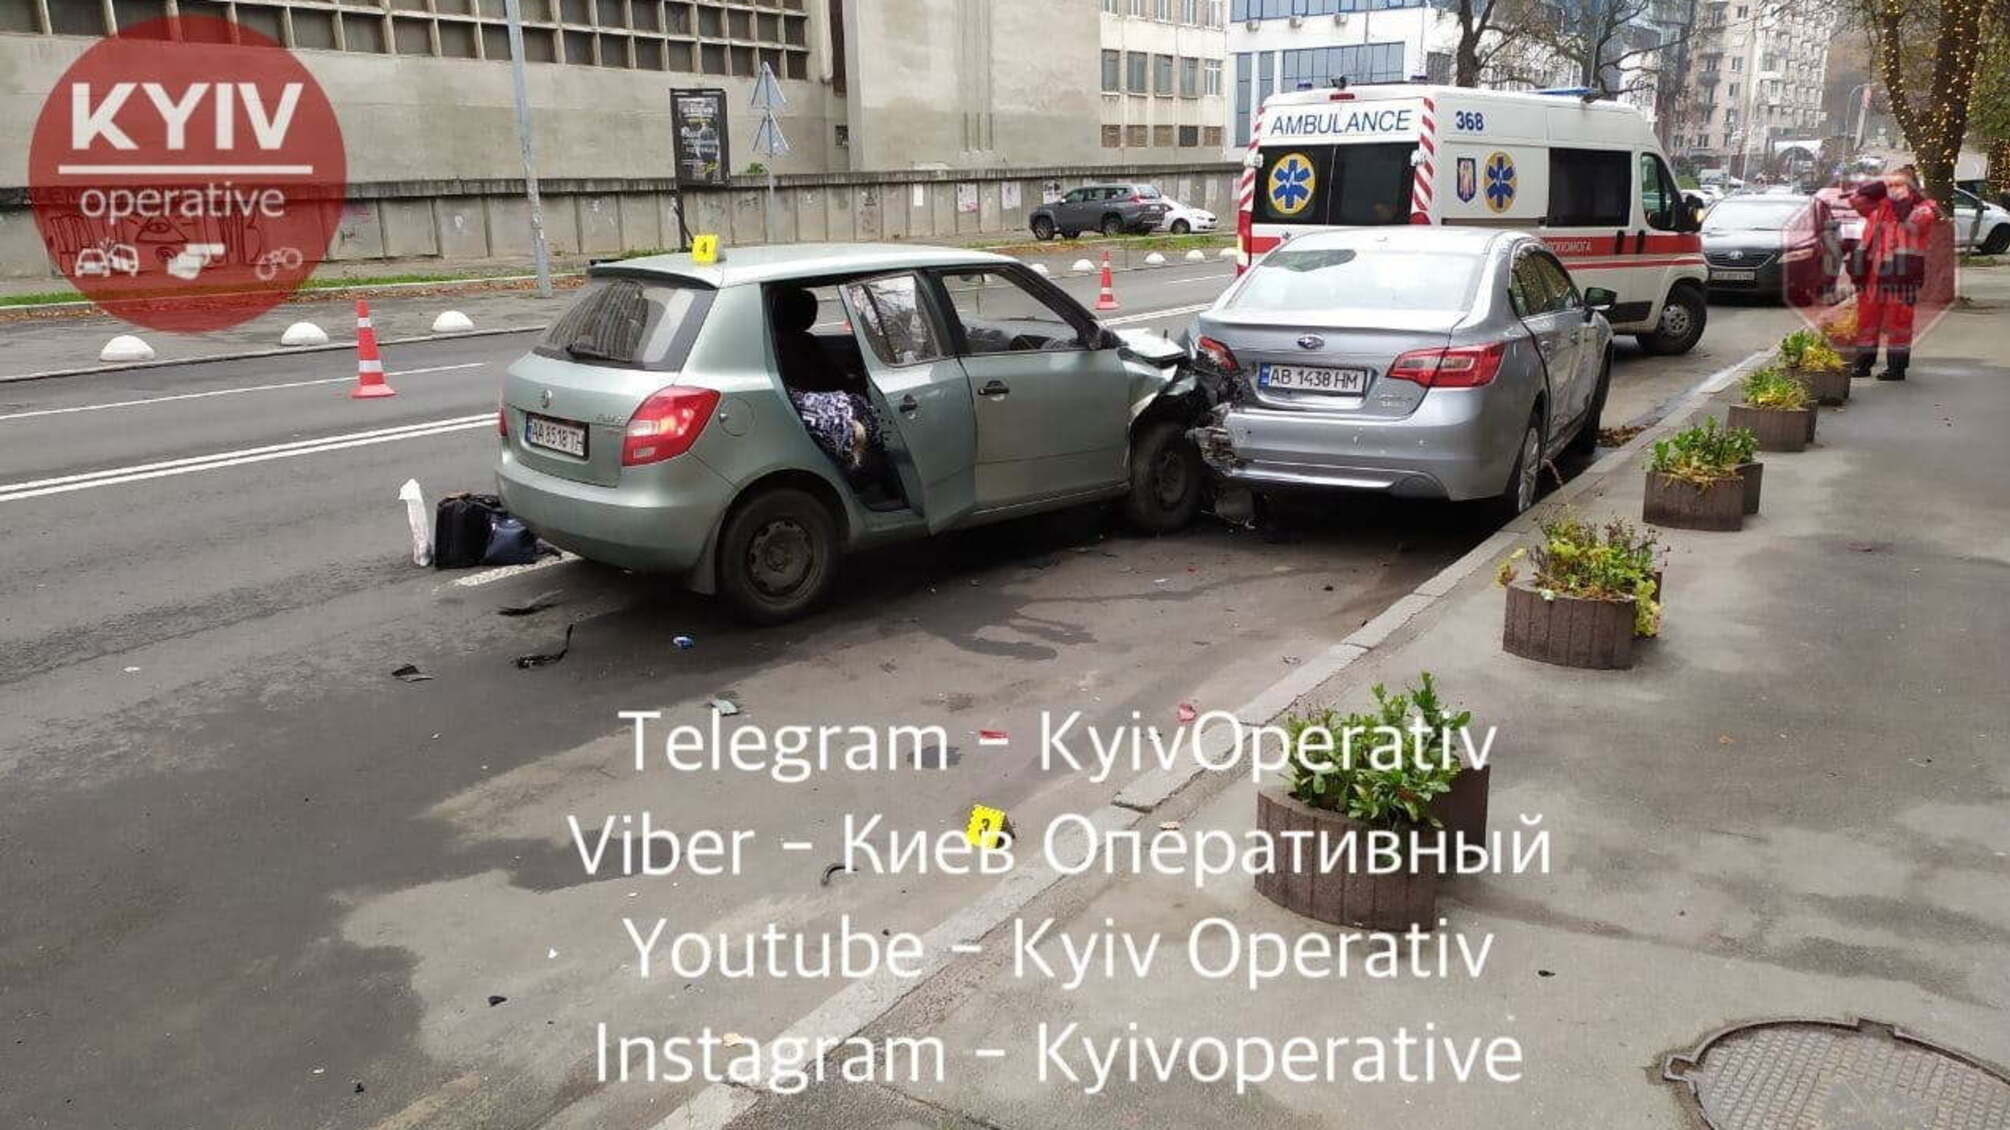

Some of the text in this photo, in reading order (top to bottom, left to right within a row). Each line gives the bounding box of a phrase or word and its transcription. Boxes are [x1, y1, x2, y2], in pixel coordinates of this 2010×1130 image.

[1270, 109, 1413, 135] AMBULANCE
[1455, 110, 1485, 131] 368
[1270, 368, 1359, 390] AB 1438 HM
